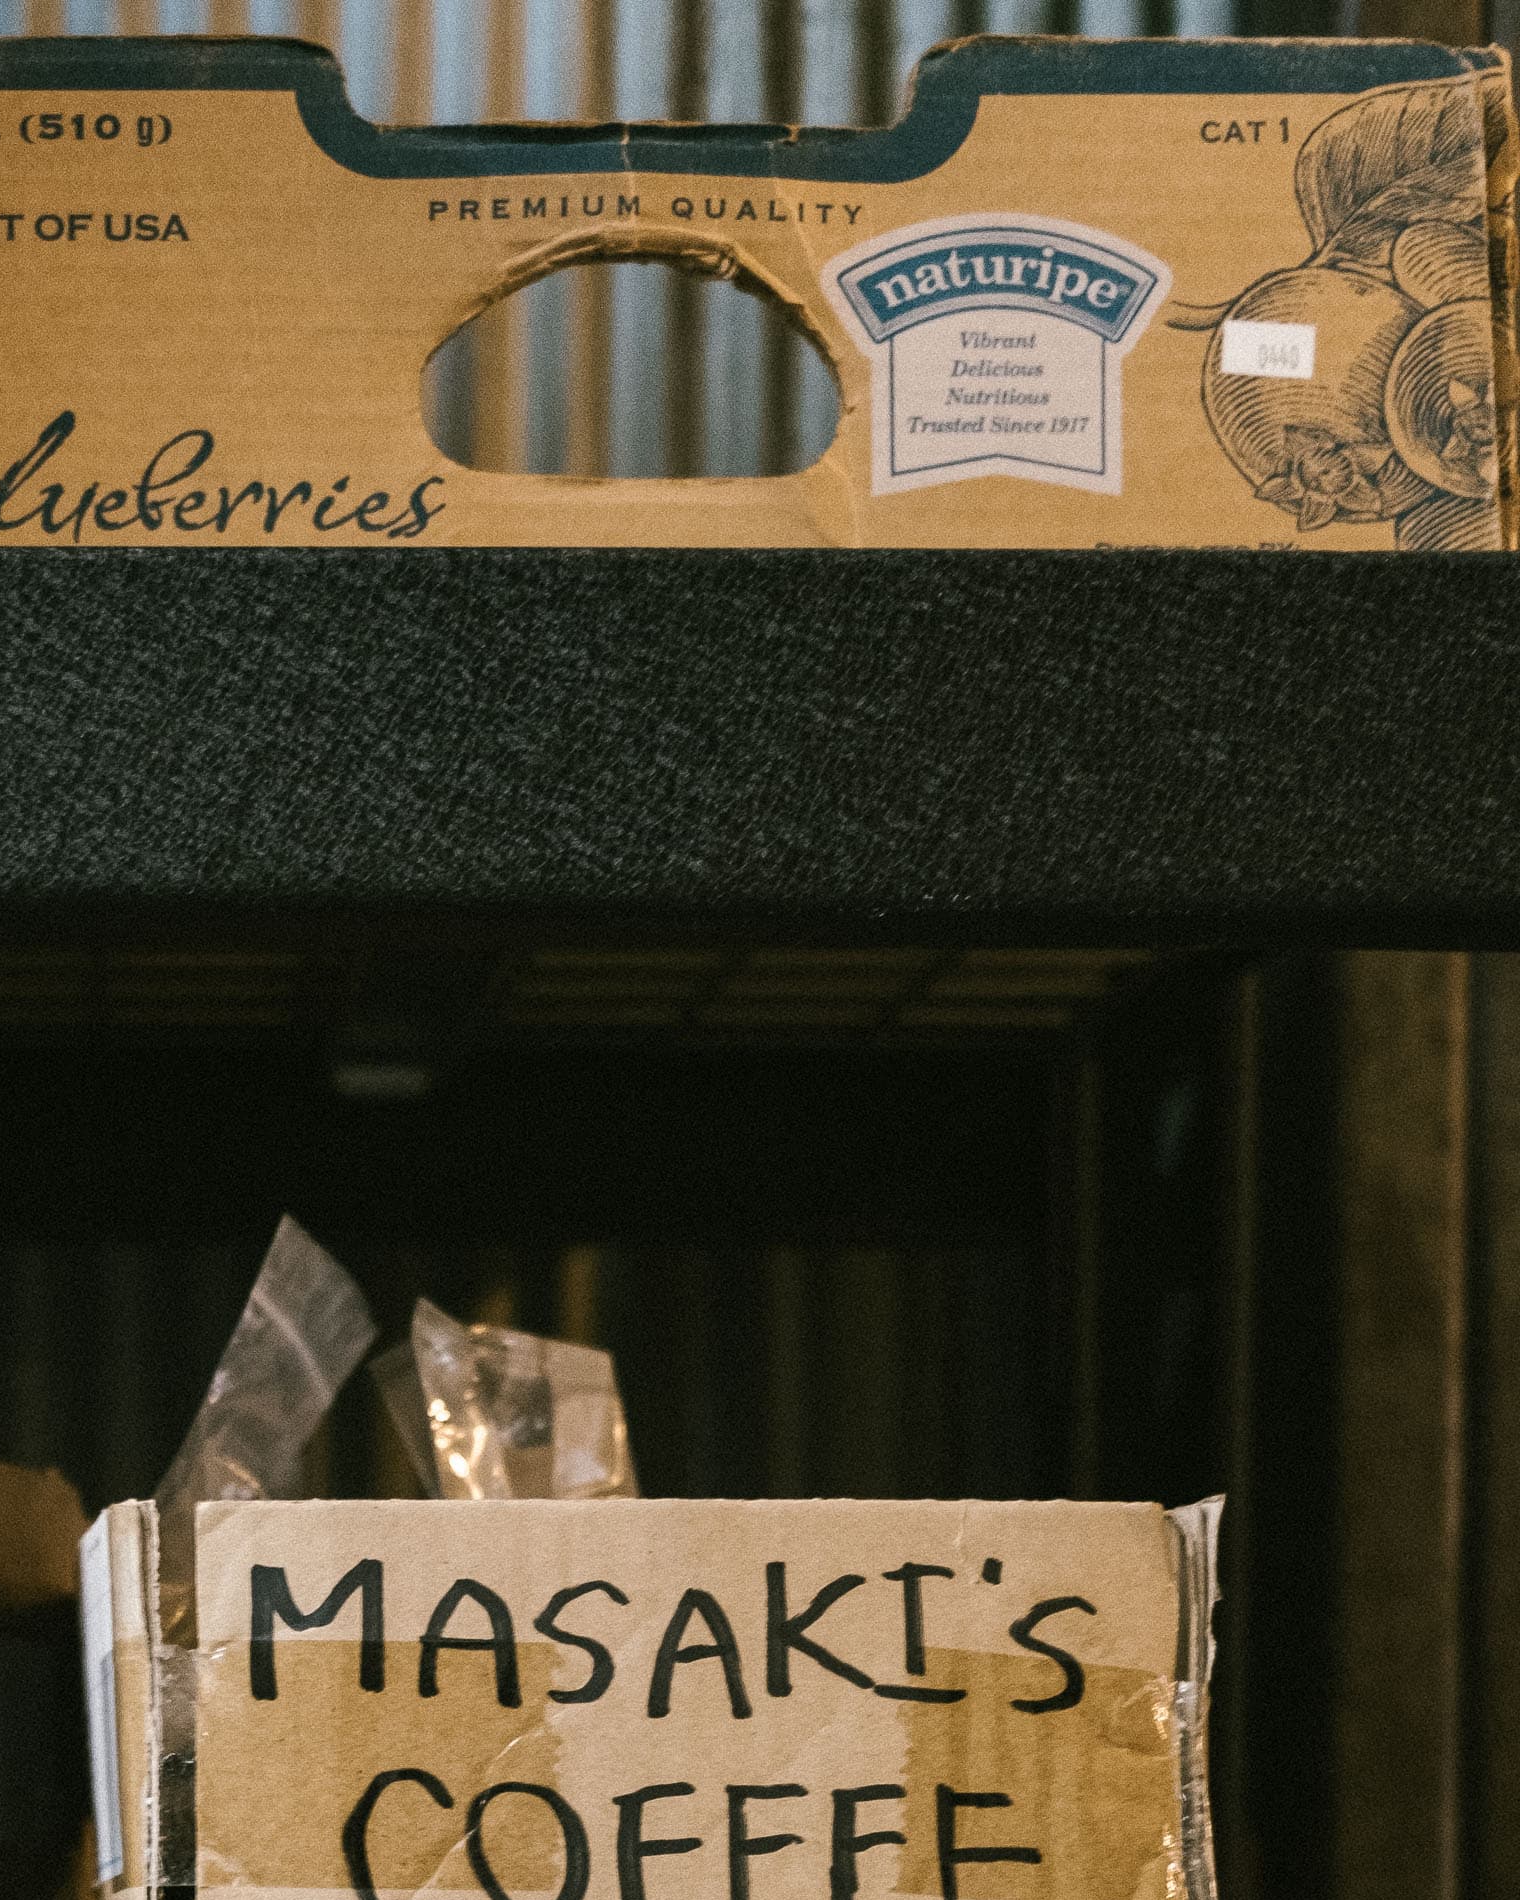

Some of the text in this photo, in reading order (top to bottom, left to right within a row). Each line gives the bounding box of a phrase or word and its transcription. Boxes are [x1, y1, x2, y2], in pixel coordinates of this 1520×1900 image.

[19, 113, 122, 144] (510
[136, 114, 172, 147] g)
[1200, 117, 1289, 143] CAT 1
[428, 195, 862, 224] PREMIUM QUALITY
[34, 214, 92, 241] OF
[104, 214, 190, 241] USA
[875, 245, 1118, 308] naturipe
[959, 331, 1035, 350] Vibrant
[950, 359, 1043, 378] Delicious
[944, 387, 1049, 406] Nutritious
[908, 415, 1090, 434] Trusted Since 1917
